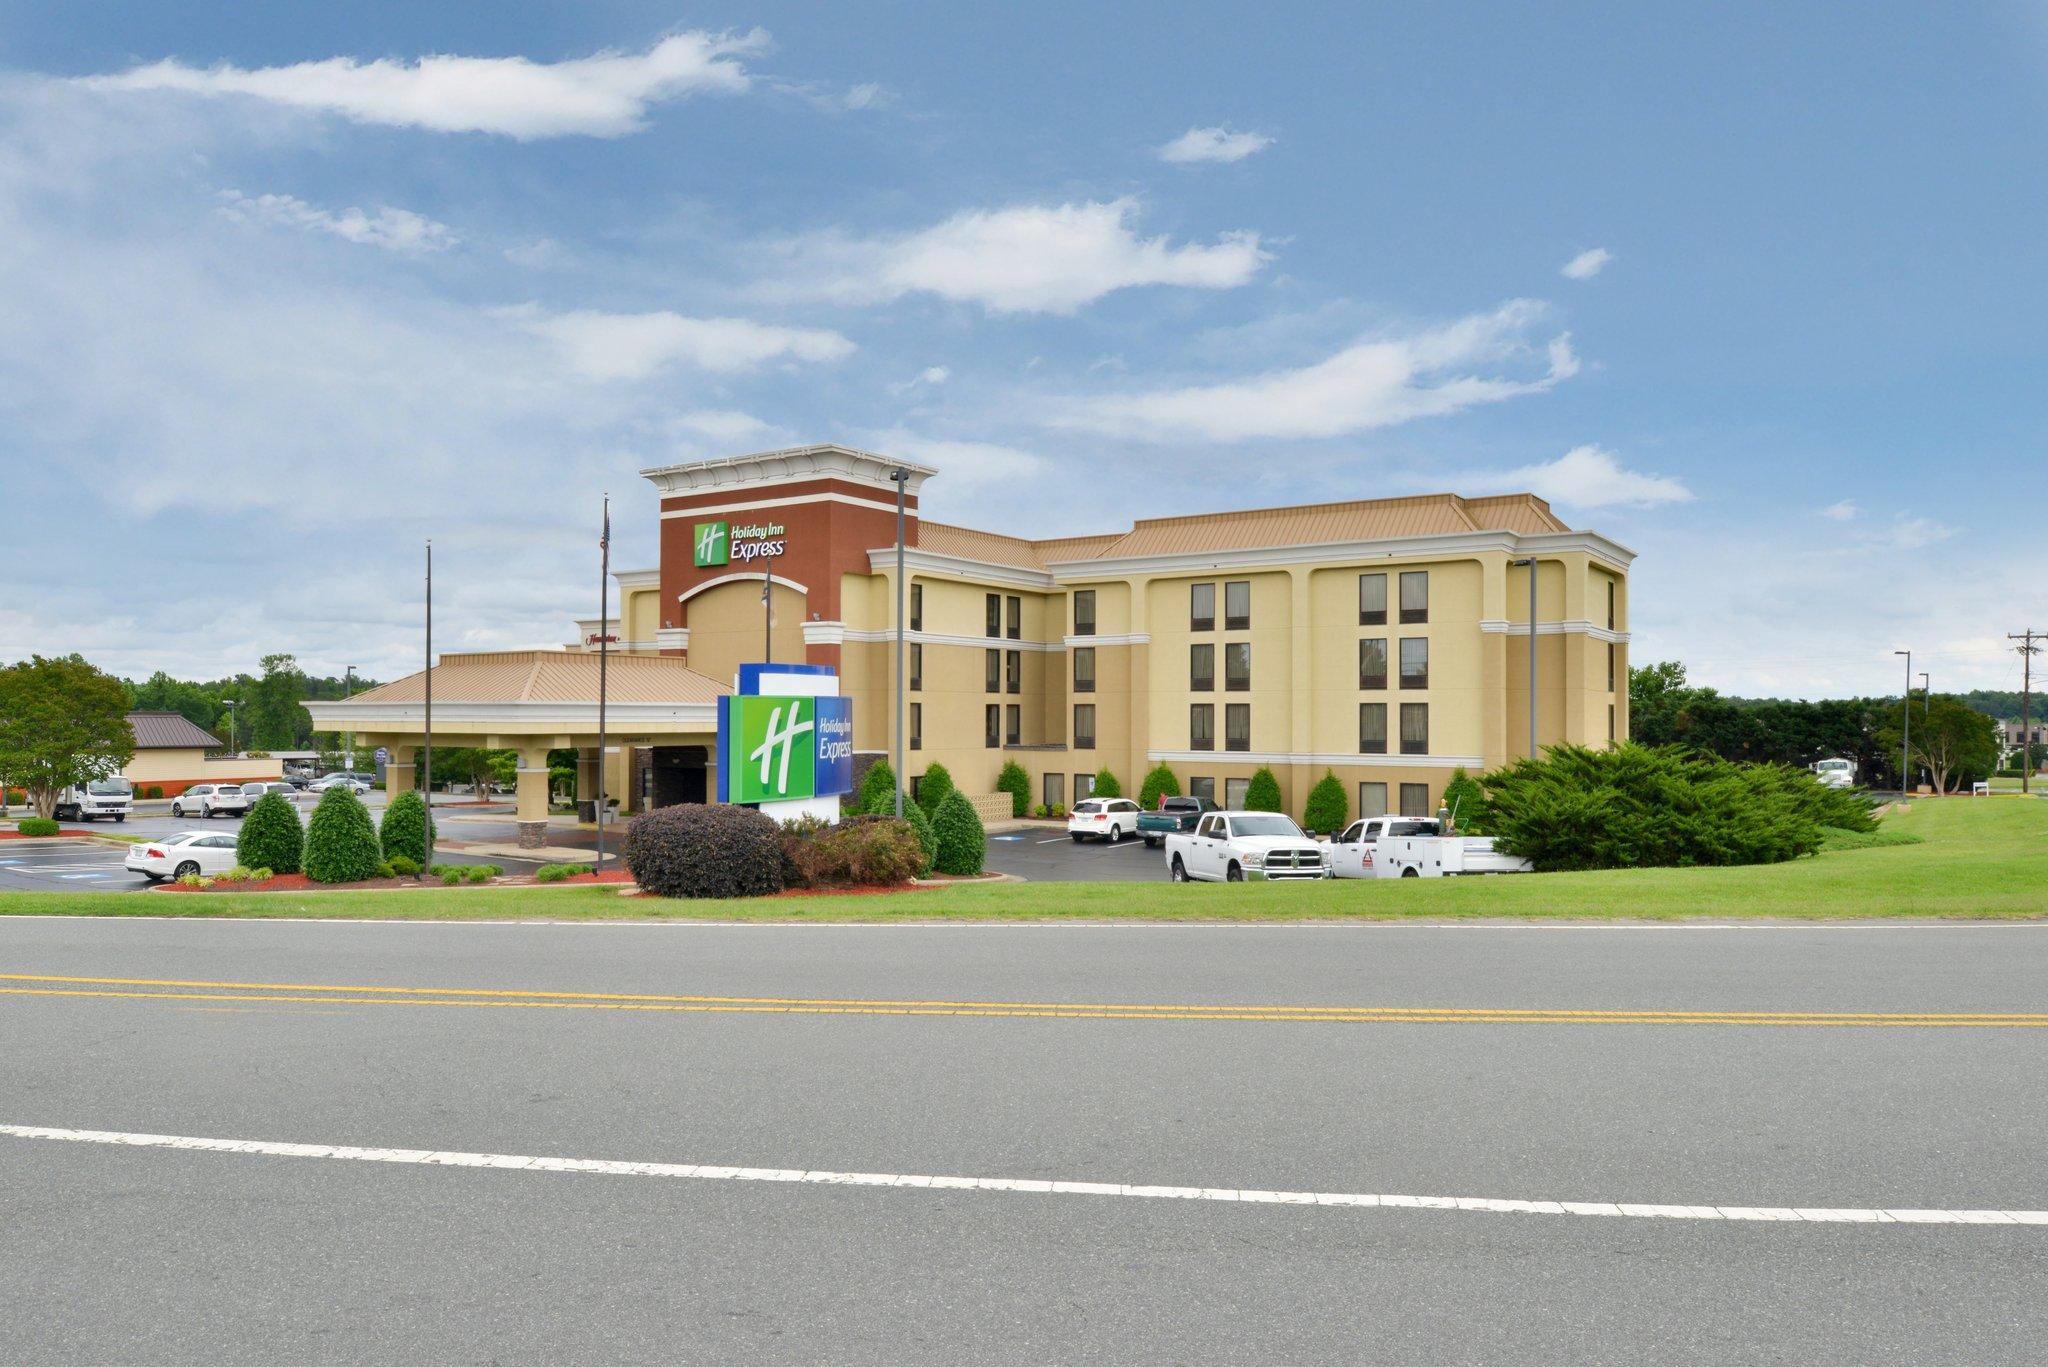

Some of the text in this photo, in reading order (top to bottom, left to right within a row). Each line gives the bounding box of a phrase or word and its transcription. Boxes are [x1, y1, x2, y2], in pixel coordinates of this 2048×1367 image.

[731, 522, 784, 540] Holiday Inn
[730, 540, 784, 563] Express
[819, 717, 844, 736] Holiday
[819, 737, 851, 764] Express
